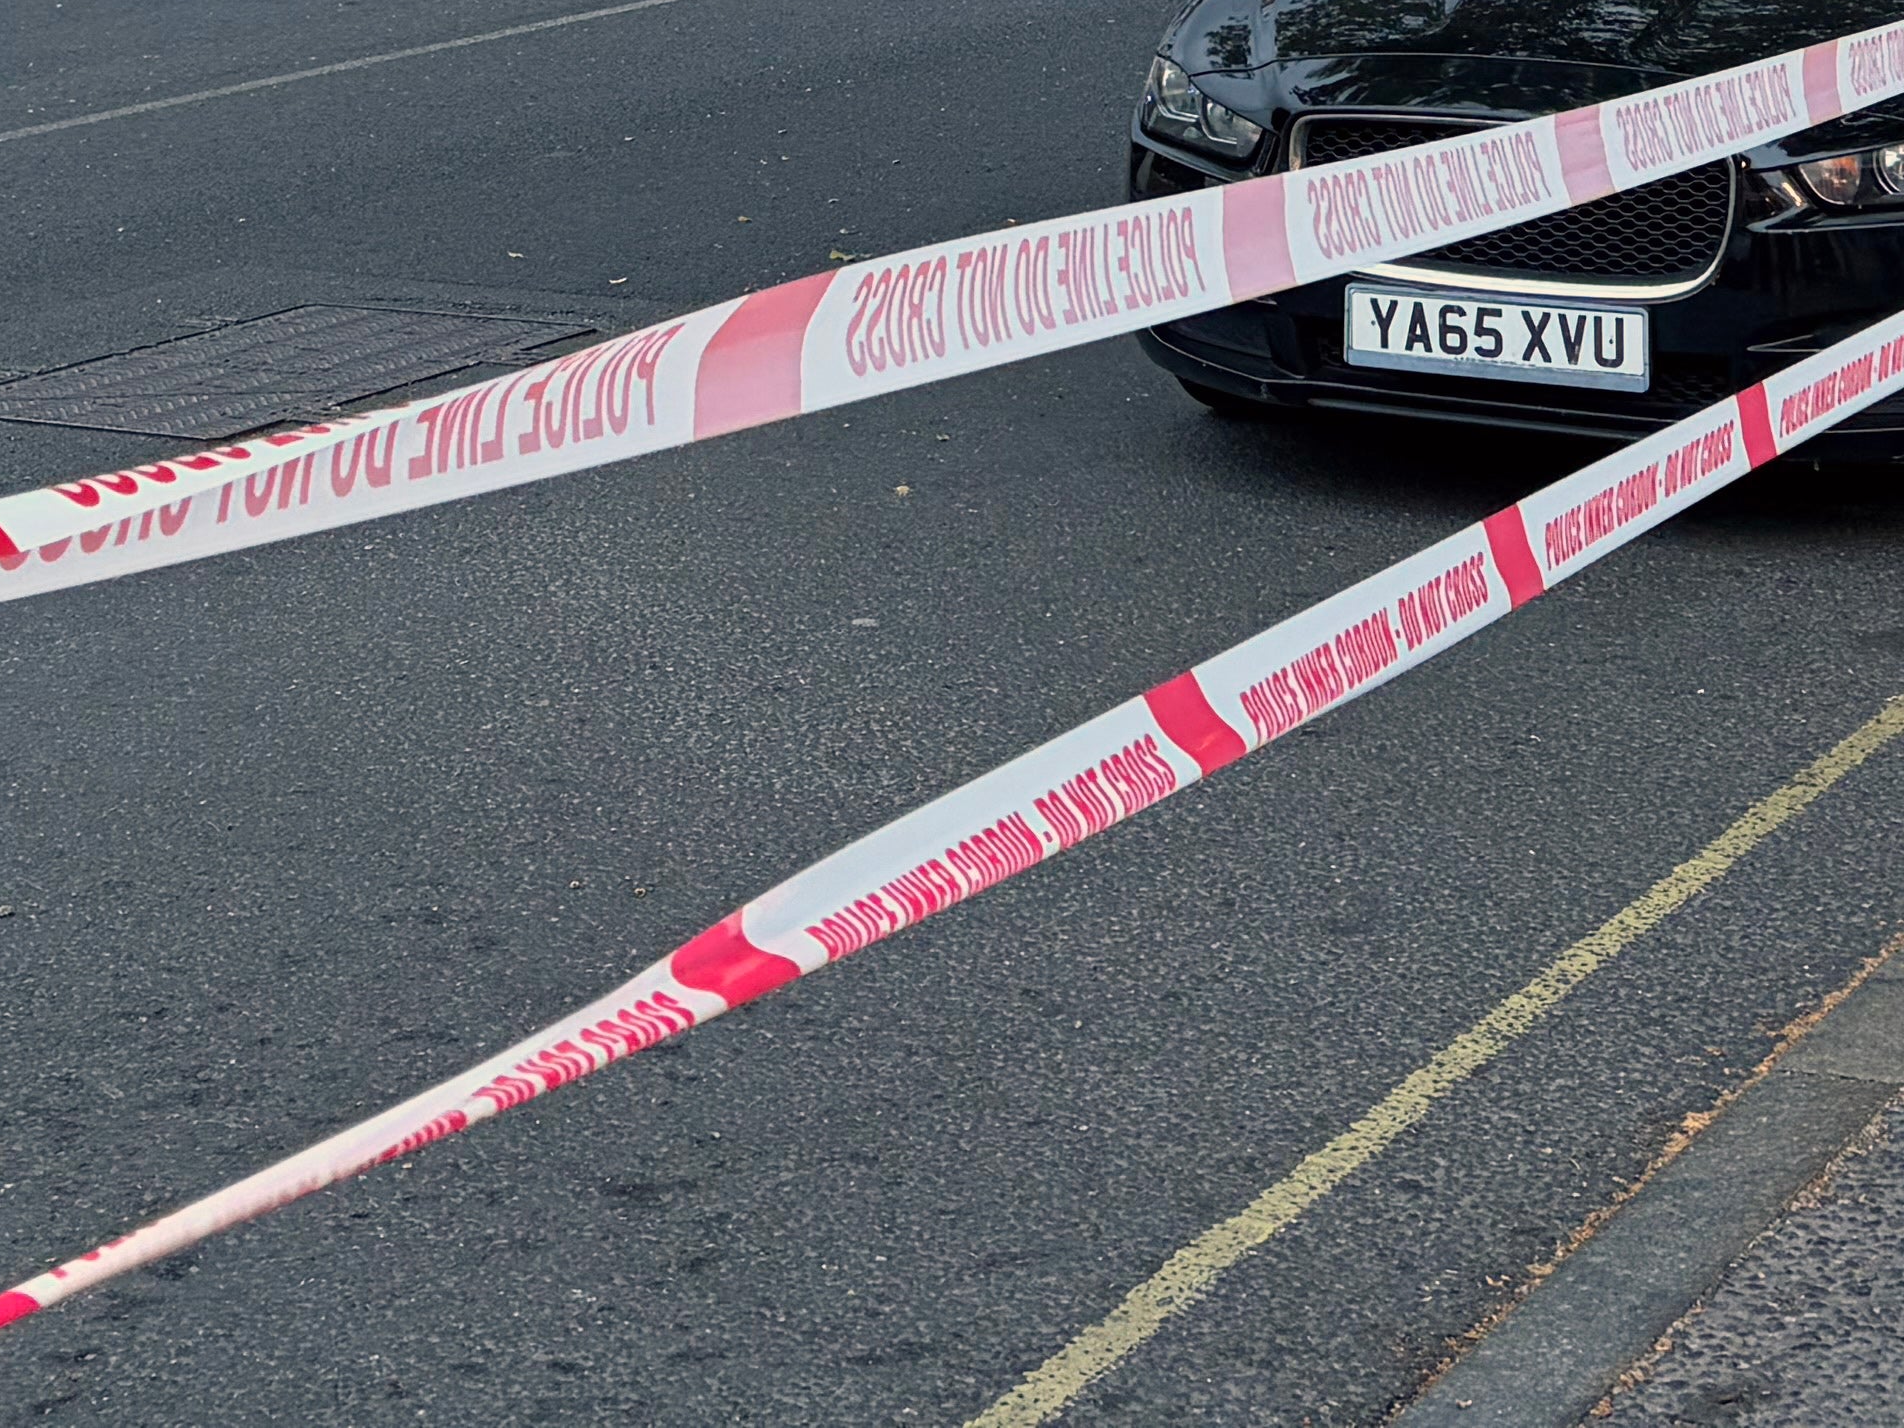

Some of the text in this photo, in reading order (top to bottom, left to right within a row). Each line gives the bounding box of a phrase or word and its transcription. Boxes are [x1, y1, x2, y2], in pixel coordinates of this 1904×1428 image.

[1370, 297, 1624, 369] YA65 XVU
[1545, 504, 1583, 571] POLICE
[1583, 486, 1615, 547] INNER
[1616, 461, 1660, 527] CORDON
[1664, 449, 1679, 498] DO
[1680, 438, 1701, 489] NOT
[1700, 419, 1734, 477] CROSS
[1239, 666, 1304, 747] POLICE
[1290, 642, 1345, 715] INNER
[1334, 607, 1398, 690] CORDON
[1398, 591, 1423, 652] DO
[1418, 575, 1448, 640] NOT
[1445, 551, 1489, 623] CROSS
[1061, 766, 1118, 835] NOT
[1100, 733, 1177, 816] CROSS
